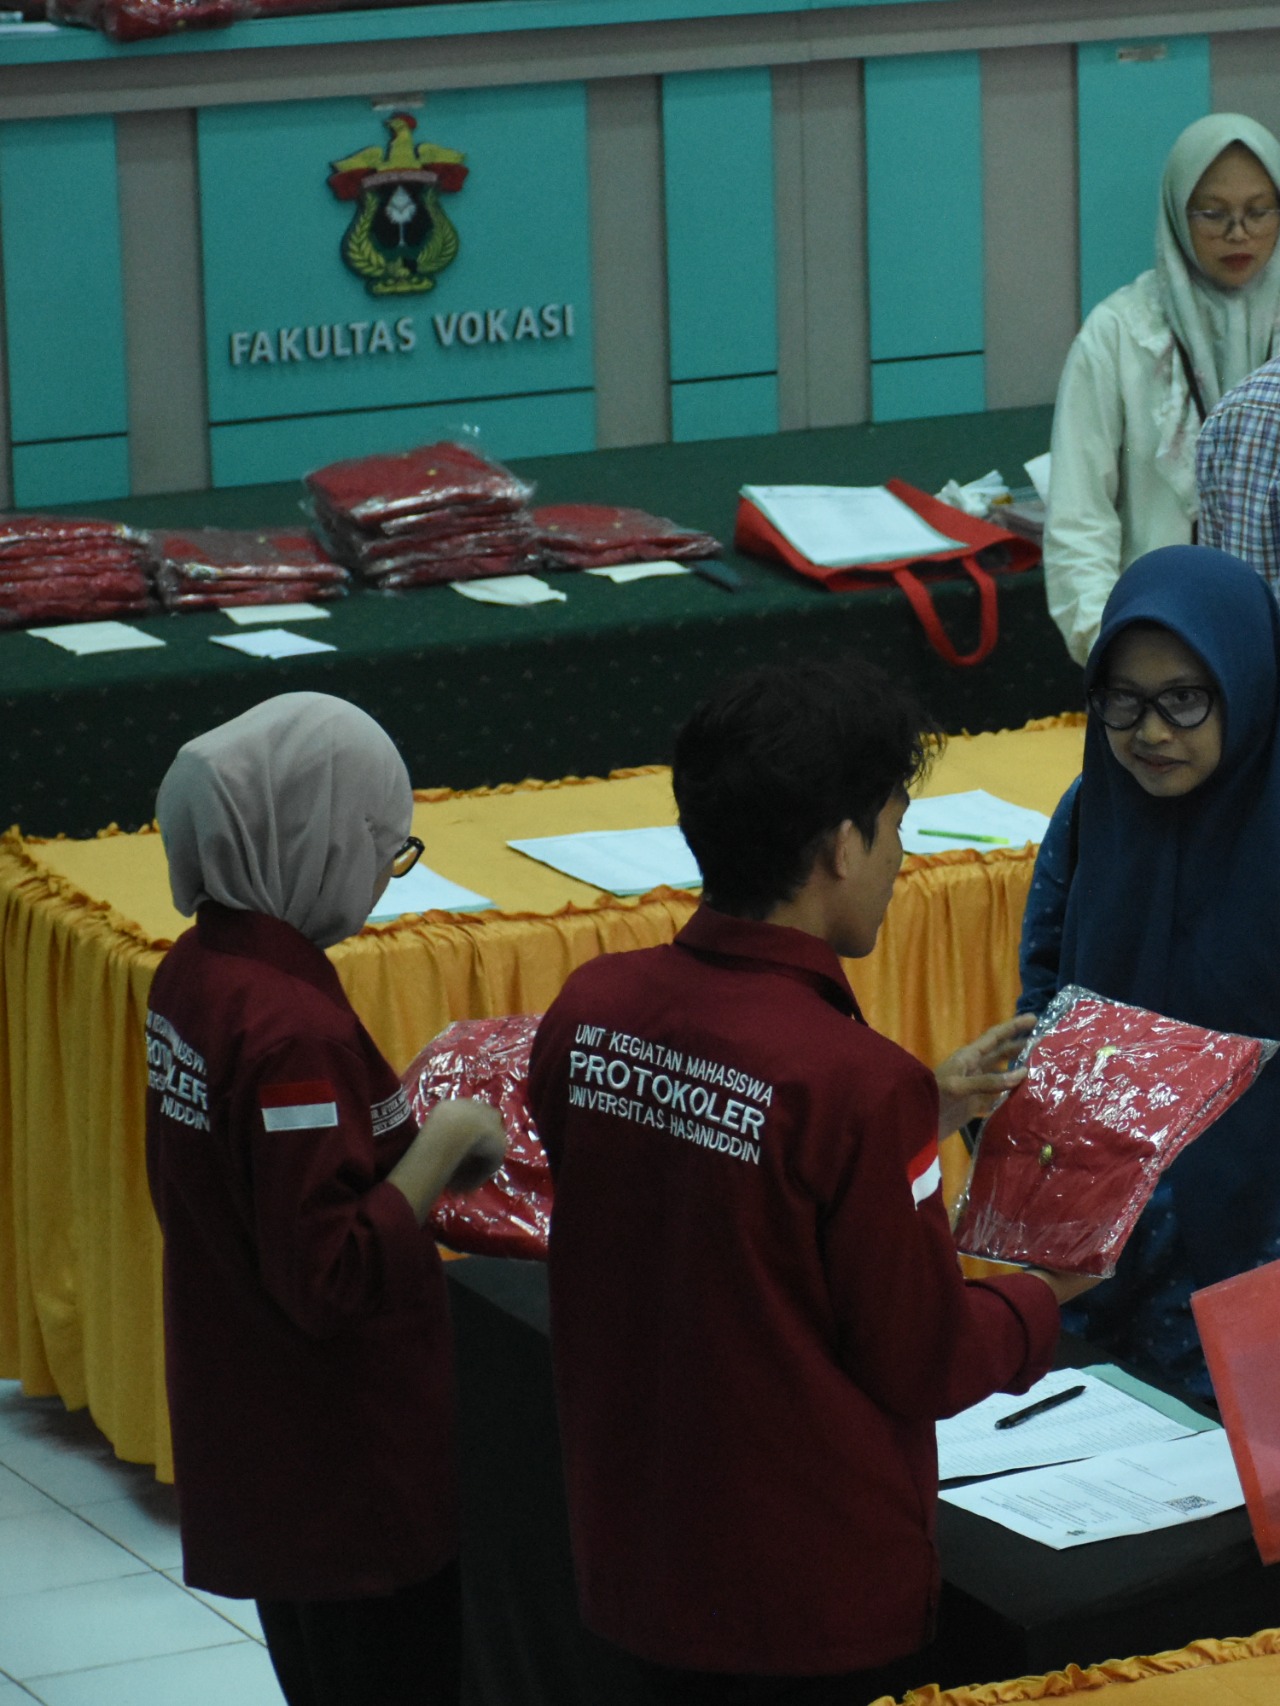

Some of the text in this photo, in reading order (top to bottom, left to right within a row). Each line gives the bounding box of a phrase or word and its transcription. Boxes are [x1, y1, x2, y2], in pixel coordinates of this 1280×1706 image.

[230, 303, 575, 365] FAKULTAS VOKASI
[569, 1050, 766, 1141] PROTOKOLER
[575, 1024, 773, 1107] UNIT KEGIATAN MAHASISWA
[568, 1084, 761, 1165] UNIVERSITAS HASANUDDIN
